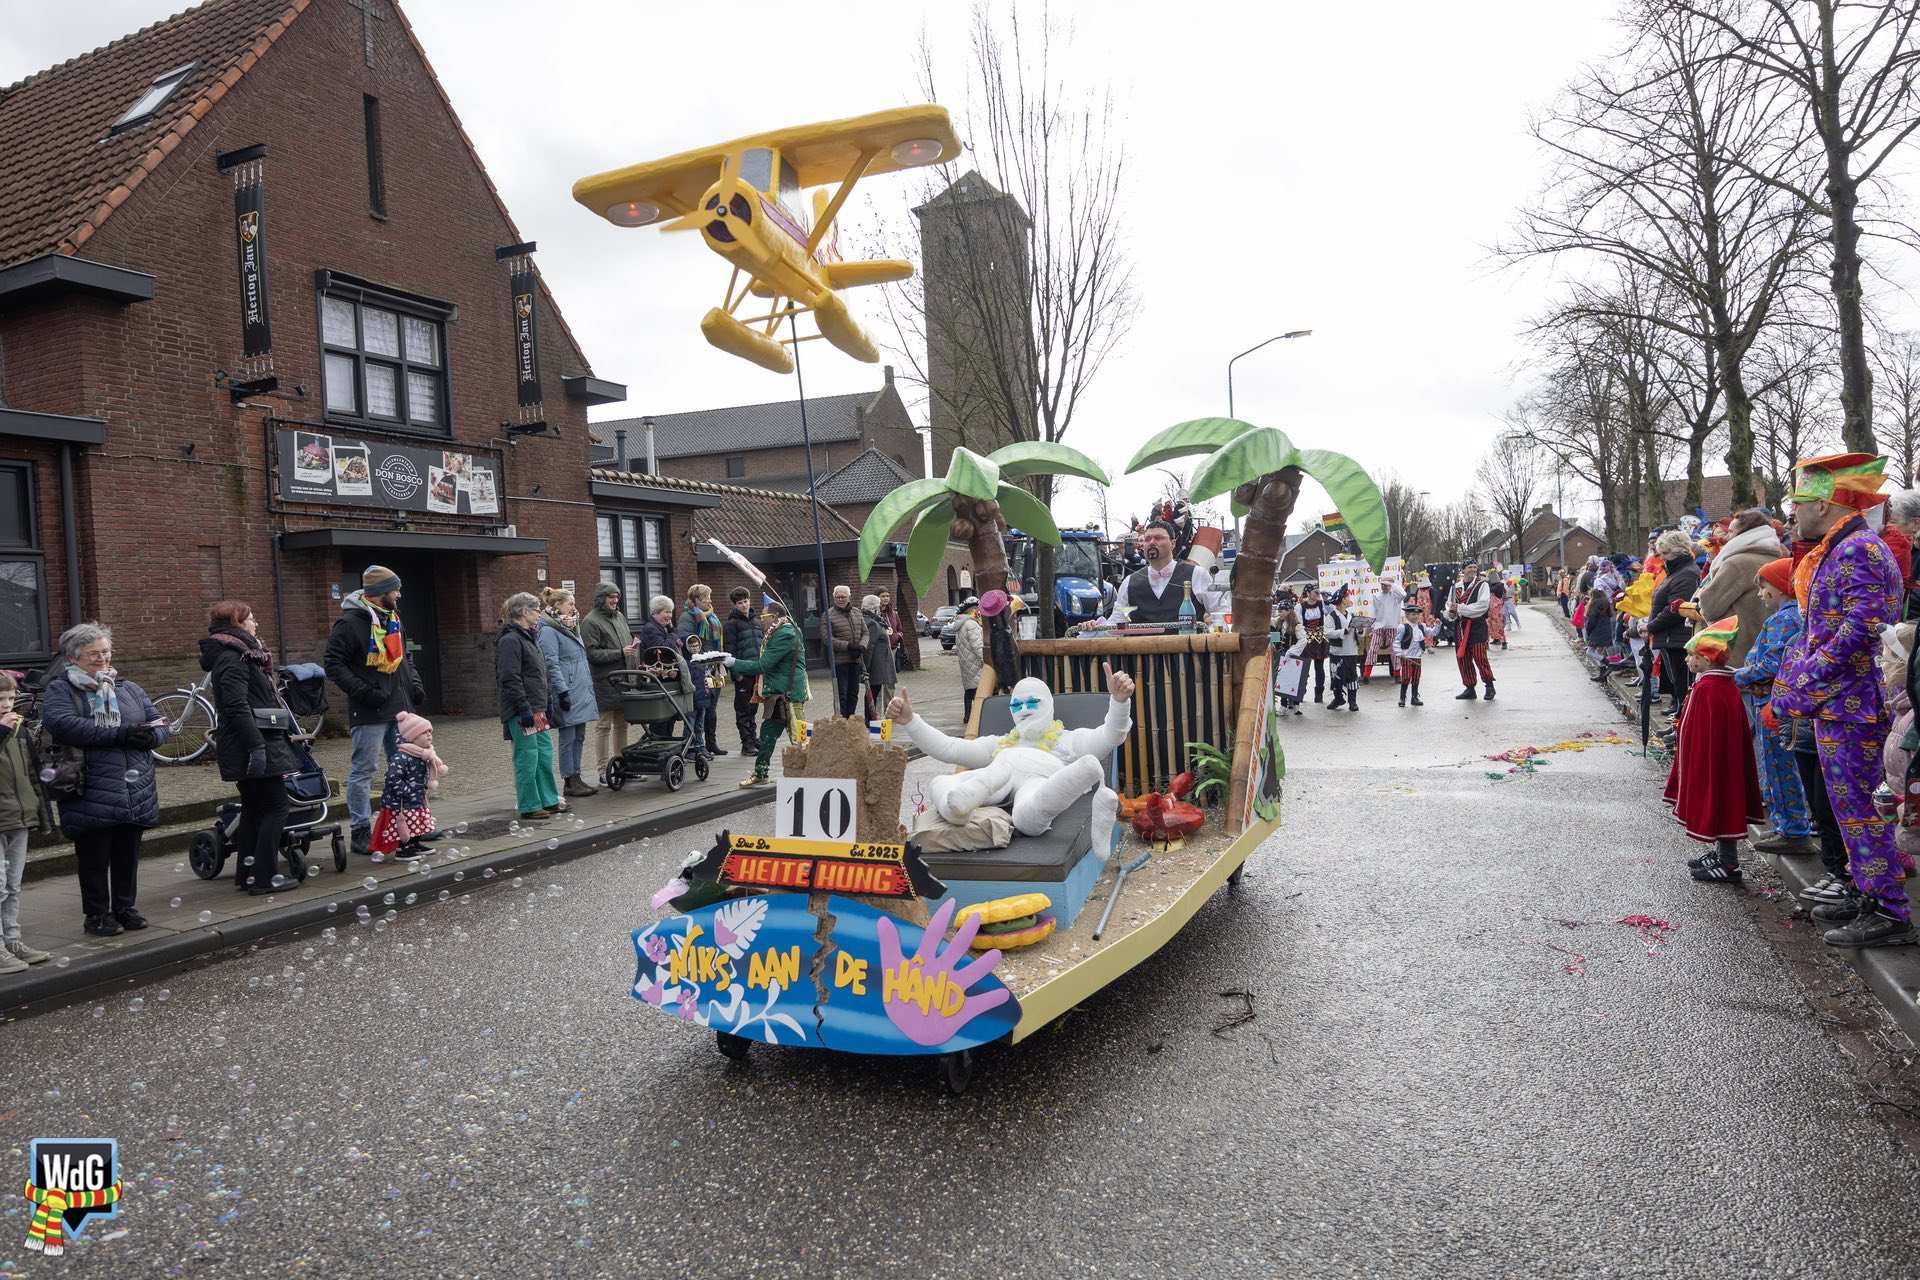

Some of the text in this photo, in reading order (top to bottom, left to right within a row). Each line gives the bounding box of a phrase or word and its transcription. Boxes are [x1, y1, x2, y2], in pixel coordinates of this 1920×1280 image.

[244, 243, 260, 325] Hertog Jan
[520, 319, 533, 382] Hertog Jan
[375, 468, 423, 486] DON BOSCO
[787, 787, 851, 839] 10
[738, 858, 893, 892] HEITE HUNG
[868, 845, 899, 859] 2025
[669, 924, 966, 1018] NIKS AAN DE HÂND
